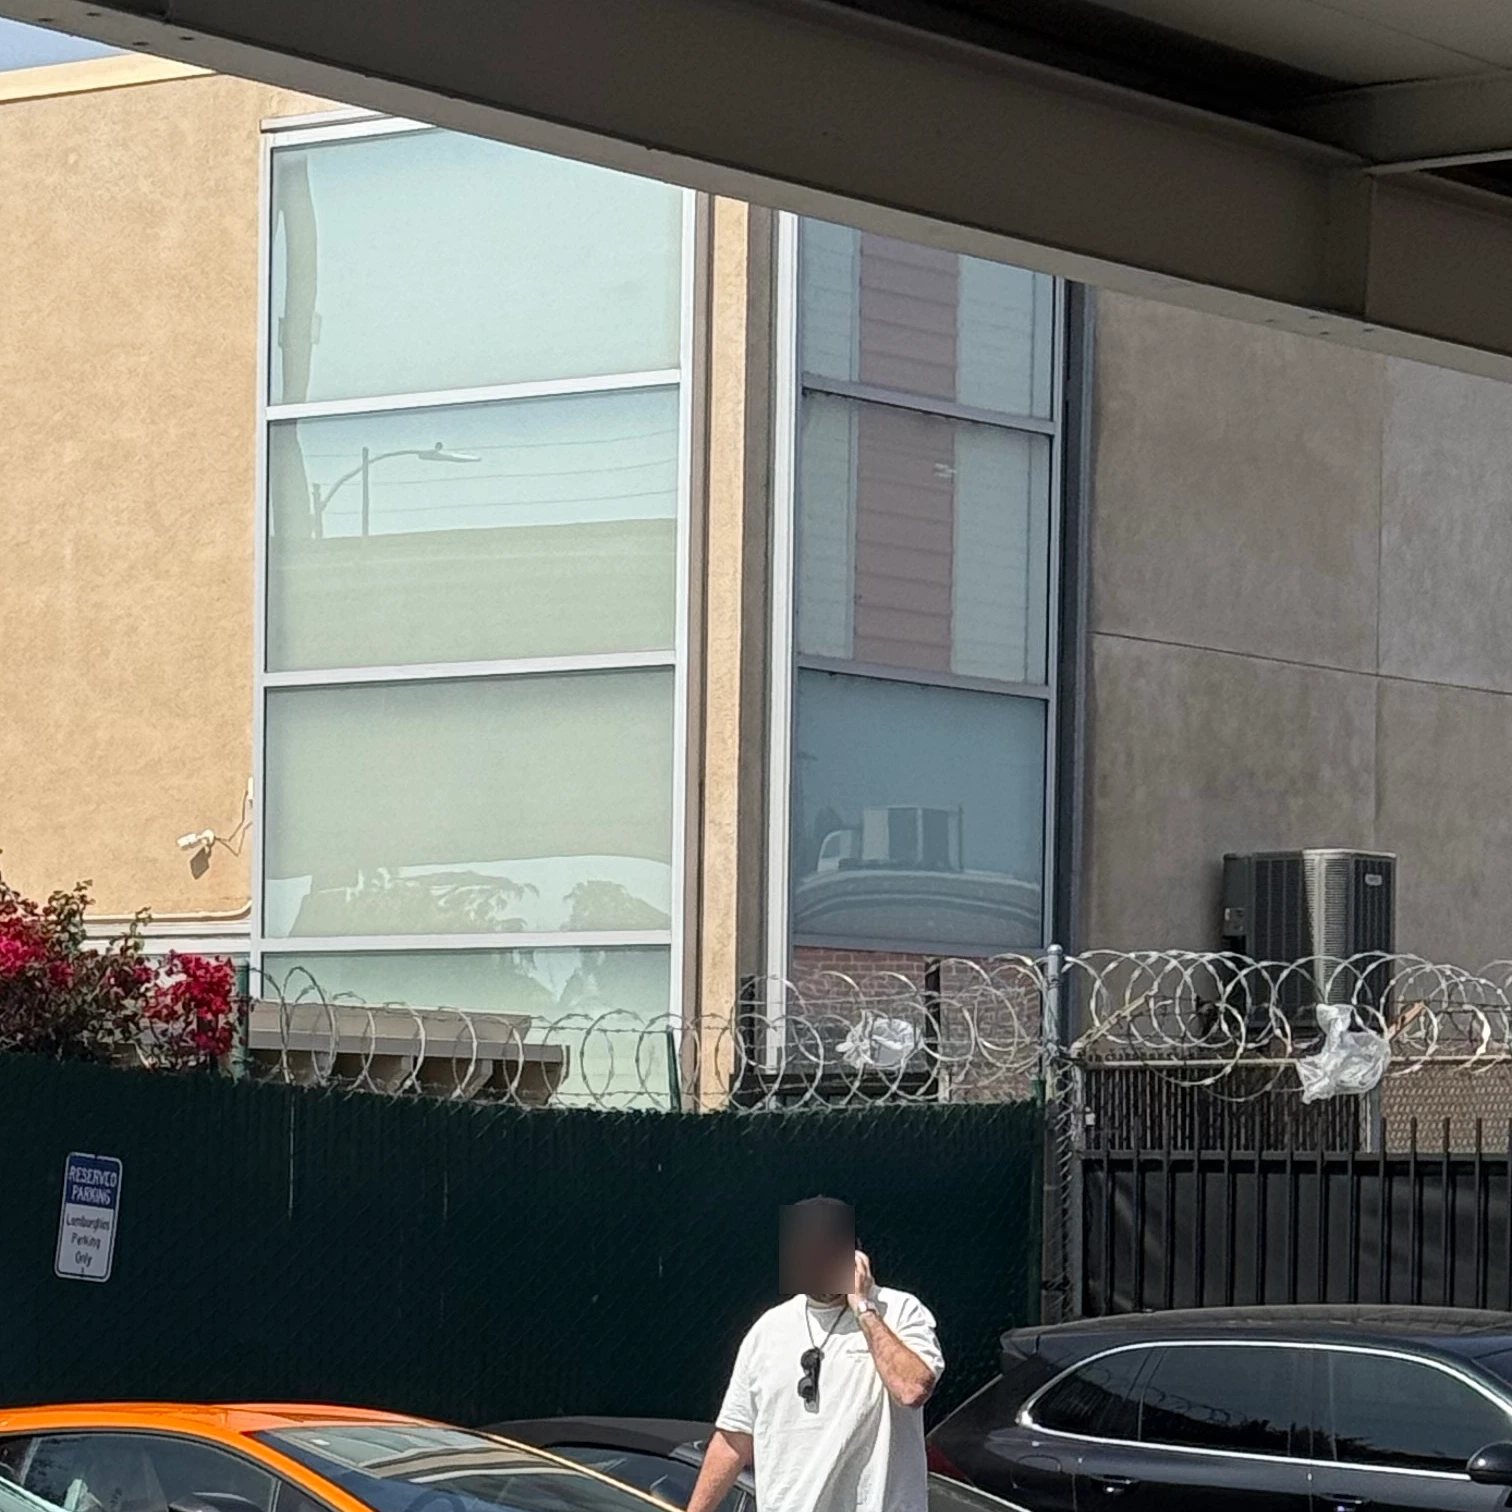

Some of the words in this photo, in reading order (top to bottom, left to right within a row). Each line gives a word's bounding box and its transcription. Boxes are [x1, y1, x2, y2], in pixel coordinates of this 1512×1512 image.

[68, 1165, 118, 1188] RESERVED
[71, 1184, 111, 1205] PARKING
[71, 1232, 101, 1249] Parking
[75, 1250, 93, 1268] Only
